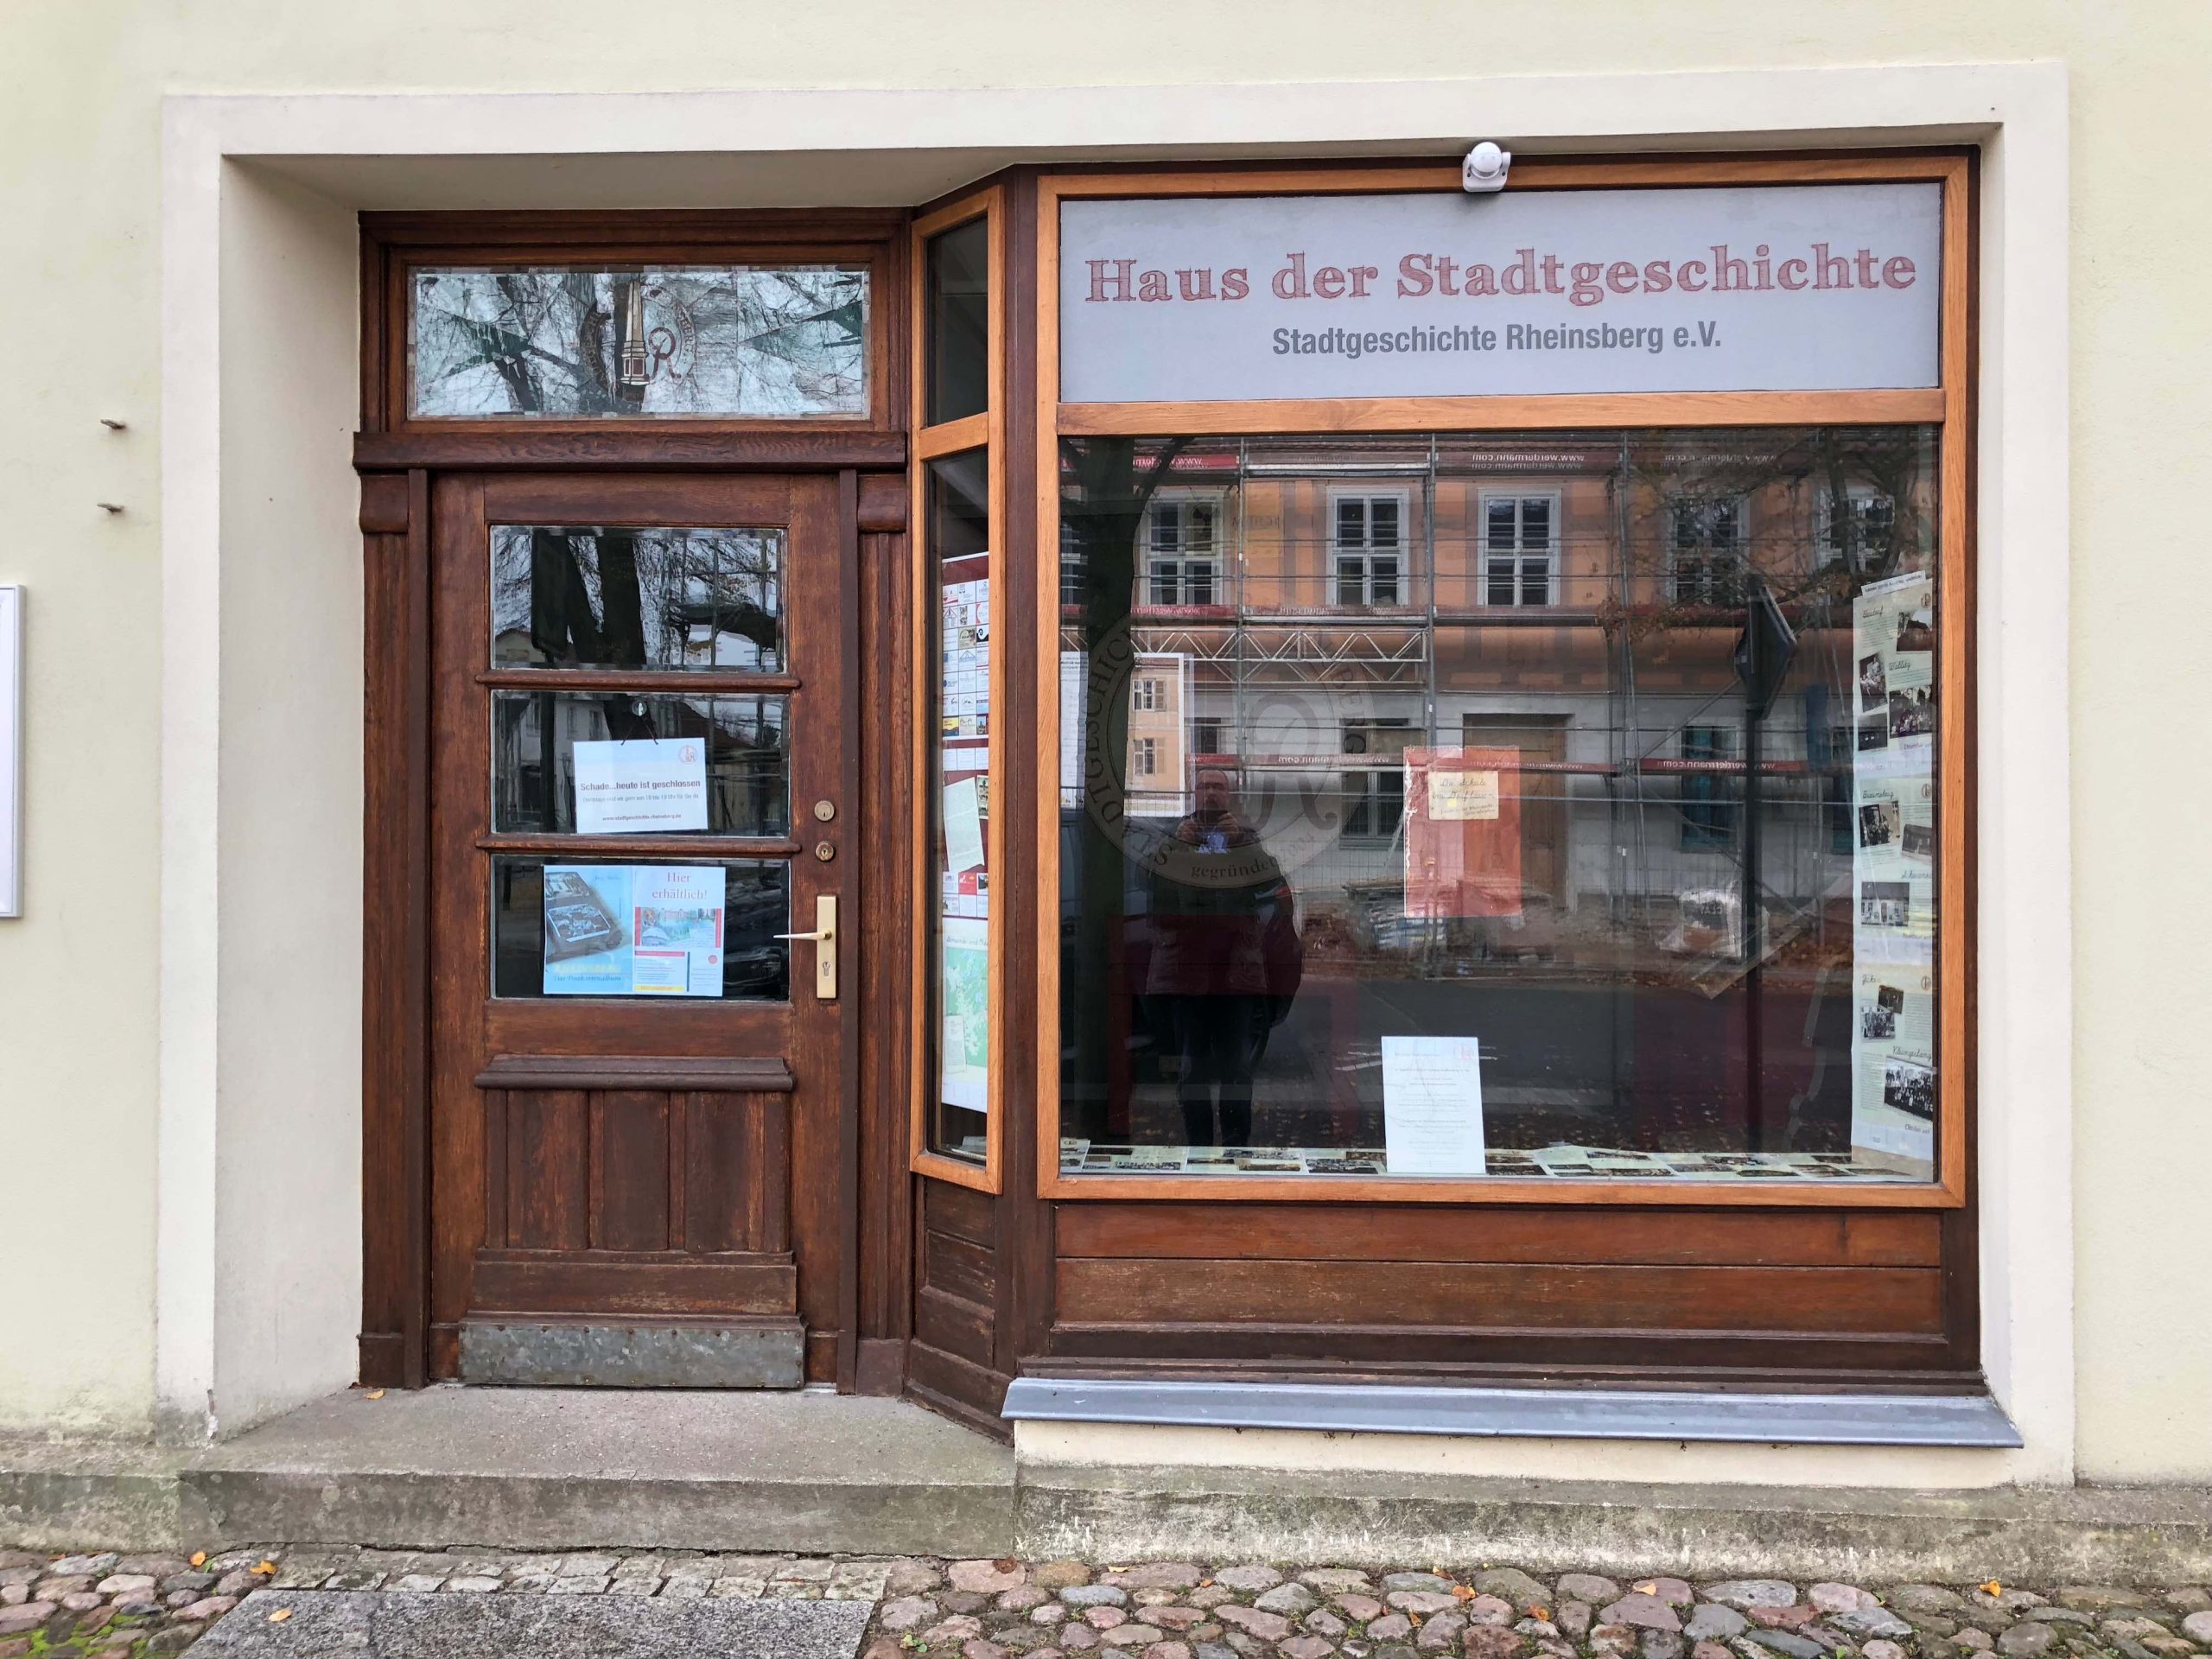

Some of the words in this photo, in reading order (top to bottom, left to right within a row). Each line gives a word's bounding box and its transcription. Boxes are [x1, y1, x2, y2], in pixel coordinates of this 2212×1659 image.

[1085, 259, 1249, 302] Haus
[1272, 251, 1378, 299] der
[1397, 244, 1916, 306] Stadtgeschichte
[1273, 325, 1497, 359] Stadtgeschichte
[1506, 322, 1663, 354] Rheinsberg
[1673, 321, 1721, 347] e.V.
[640, 780, 650, 789] ist
[652, 779, 701, 790] geschlossen
[667, 872, 691, 883] Hier
[652, 888, 708, 899] erhältlich!
